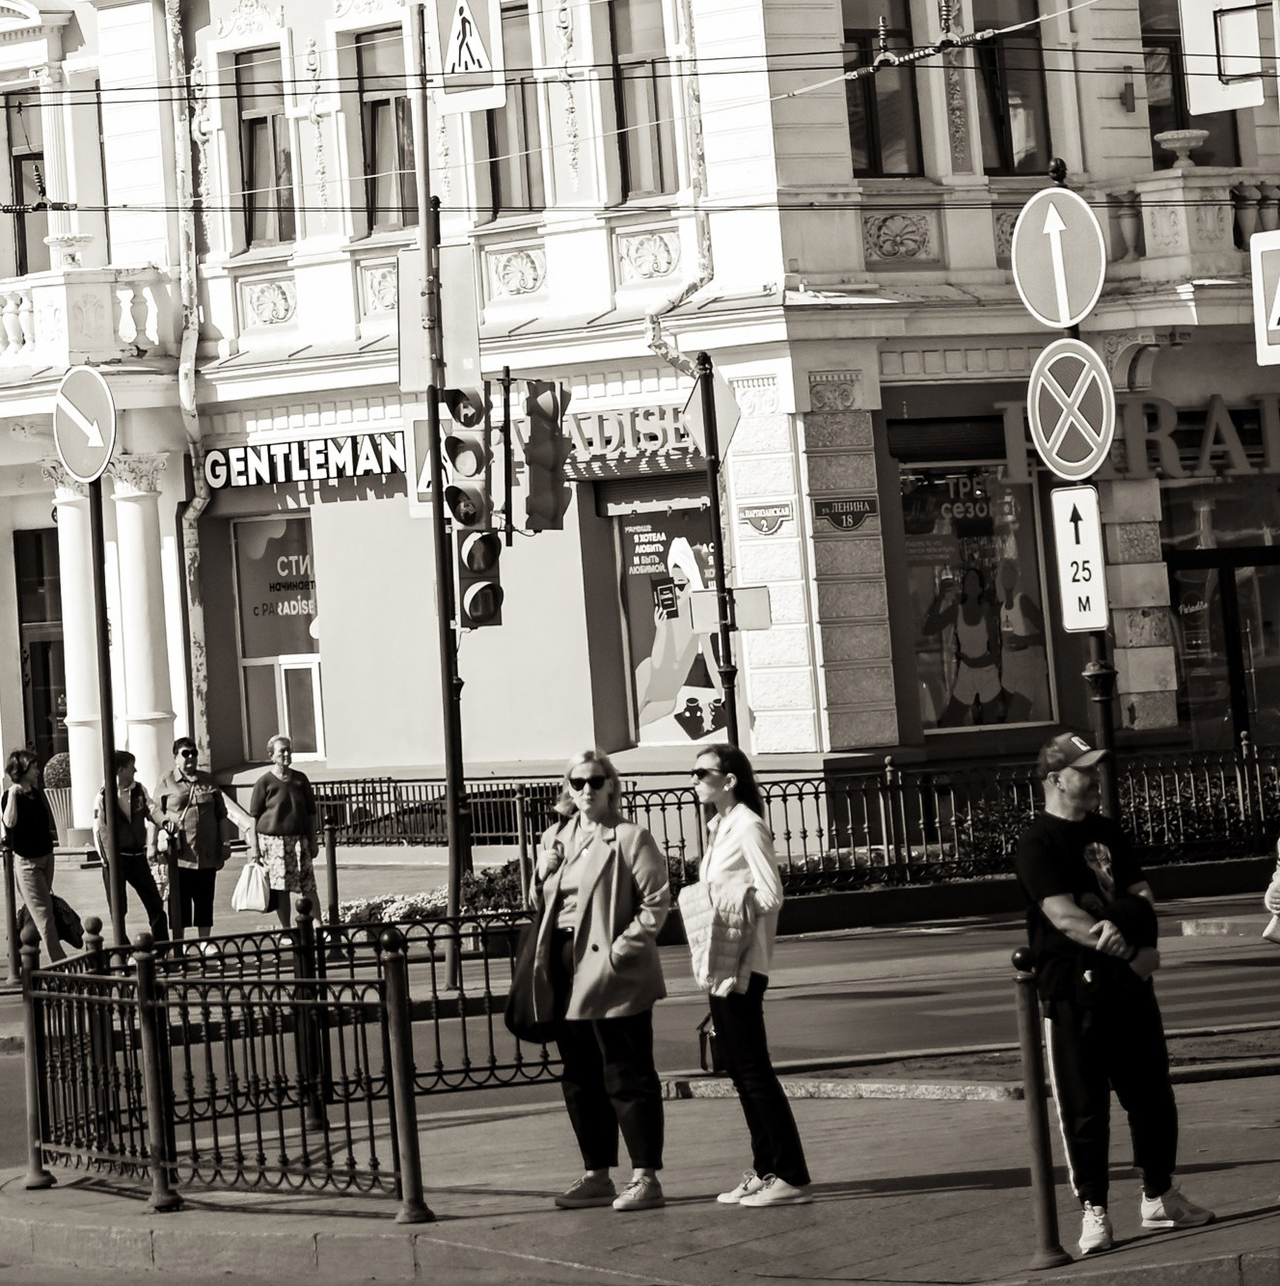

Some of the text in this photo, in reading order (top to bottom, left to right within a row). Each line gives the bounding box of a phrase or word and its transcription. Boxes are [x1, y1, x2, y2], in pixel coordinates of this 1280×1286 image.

[204, 431, 407, 489] GENTLEMAN
[832, 501, 870, 513] ЛЕНИНА
[941, 502, 991, 519] сезо
[760, 519, 768, 531] 2
[842, 515, 853, 527] 18
[634, 532, 667, 543] Я ХОТЕЛА
[635, 543, 664, 553] ЛЮБИТЬ
[633, 554, 659, 564] И БЫТЬ
[1070, 560, 1092, 583] 25
